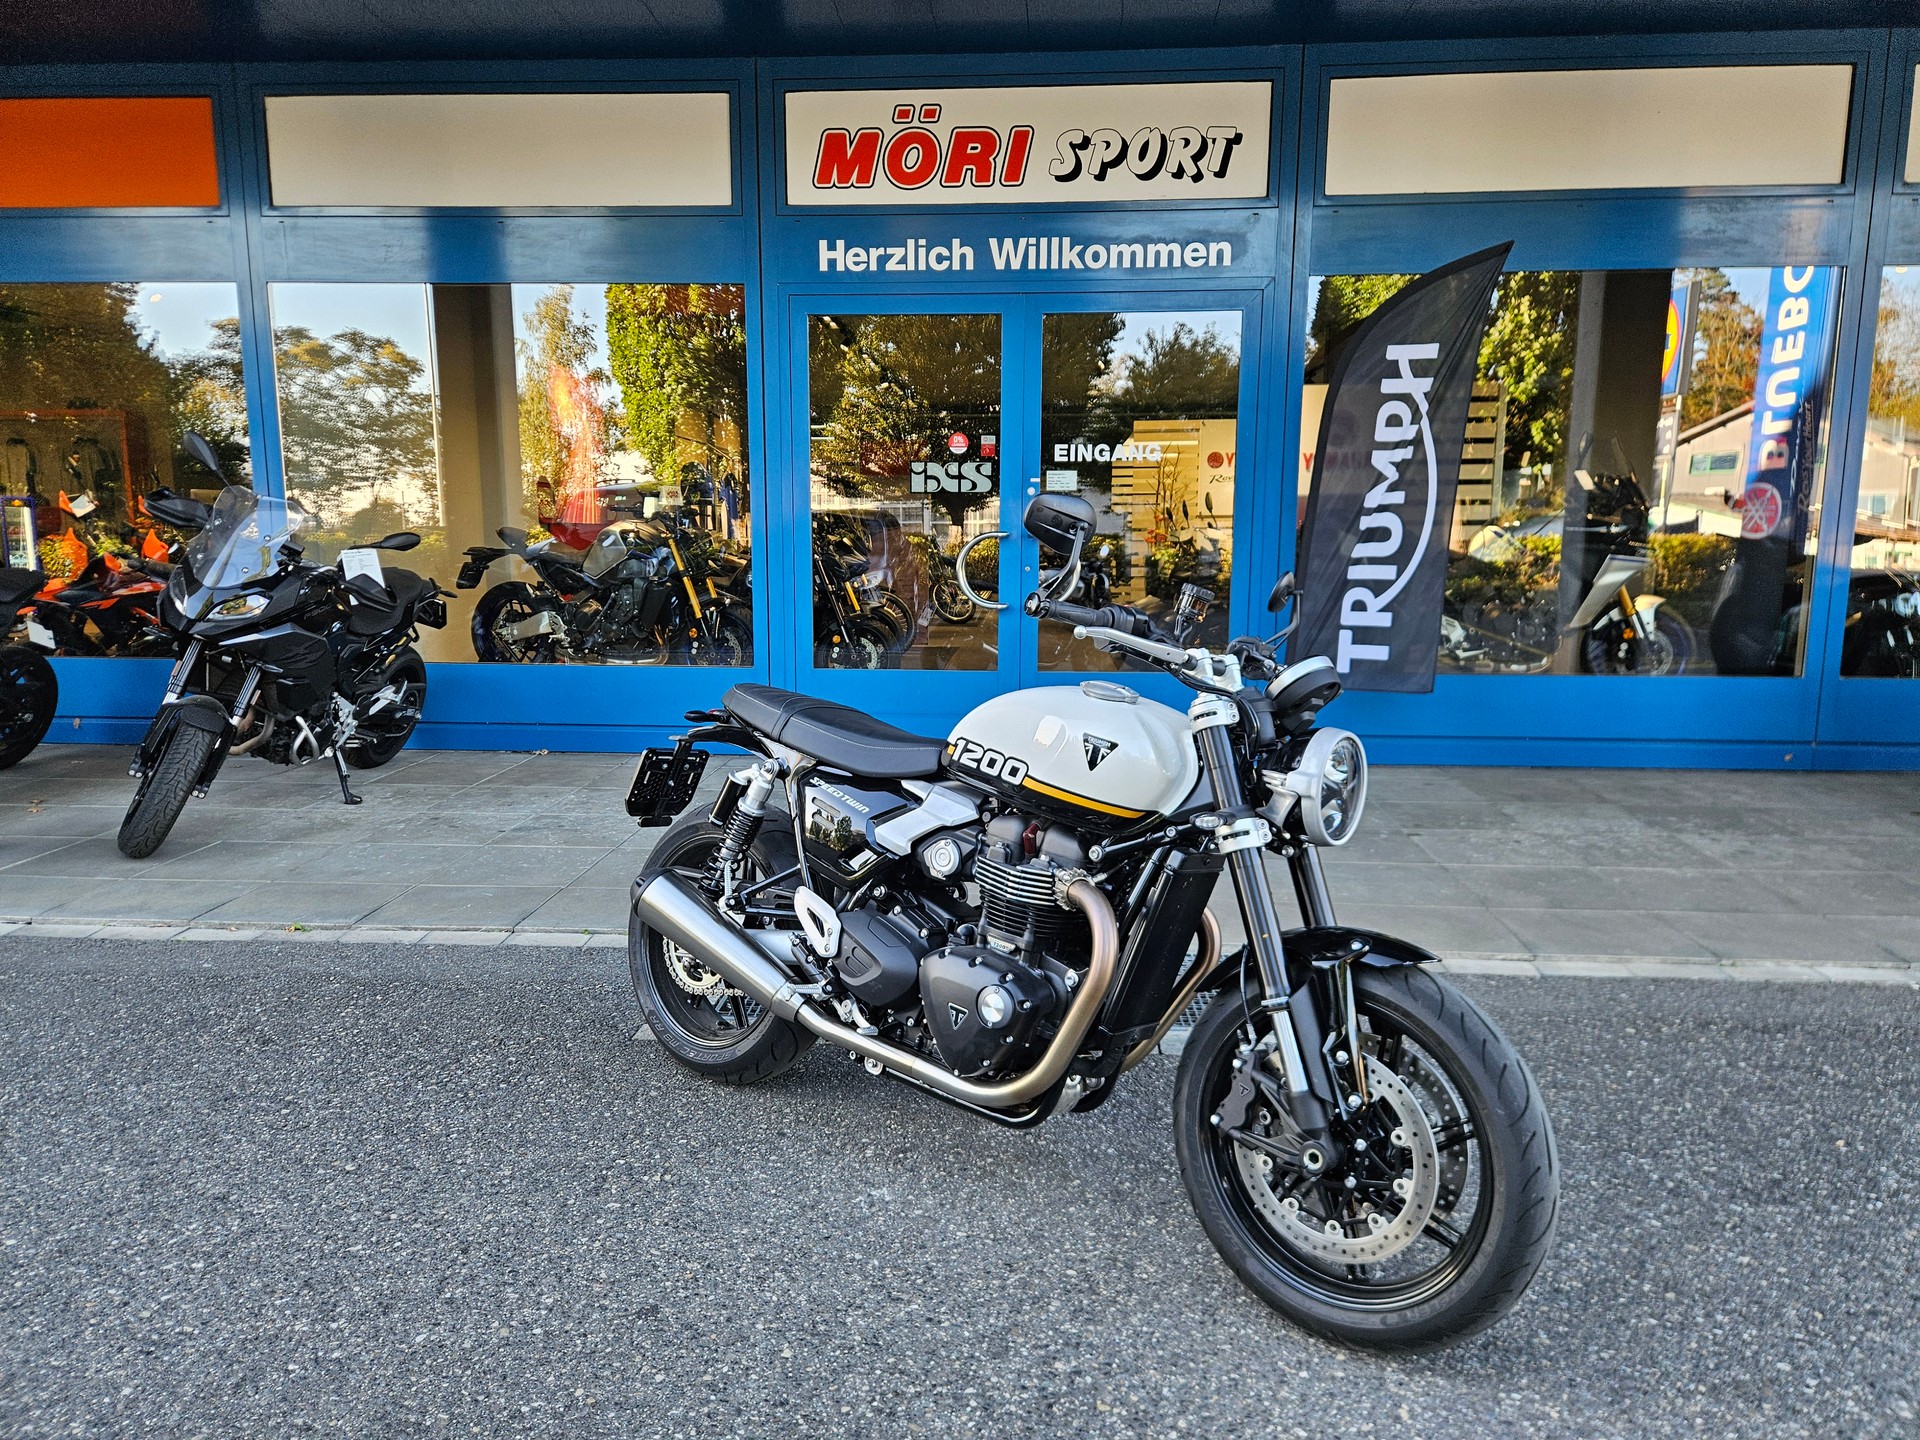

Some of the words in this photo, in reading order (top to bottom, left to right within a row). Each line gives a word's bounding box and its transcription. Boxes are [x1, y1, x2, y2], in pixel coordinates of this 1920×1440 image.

[812, 104, 1035, 190] MÖRI
[1048, 125, 1243, 183] SPORT
[818, 238, 974, 272] Herzlich
[988, 236, 1232, 270] Willkommen
[953, 435, 964, 443] 0%
[1053, 443, 1162, 463] EINGANG
[1209, 474, 1234, 484] Rev
[1336, 342, 1440, 674] TRIUMPH
[951, 738, 1029, 786] 1200
[809, 776, 844, 798] SPEED
[841, 794, 870, 814] TWIN
[680, 1046, 734, 1062] SPORTEC
